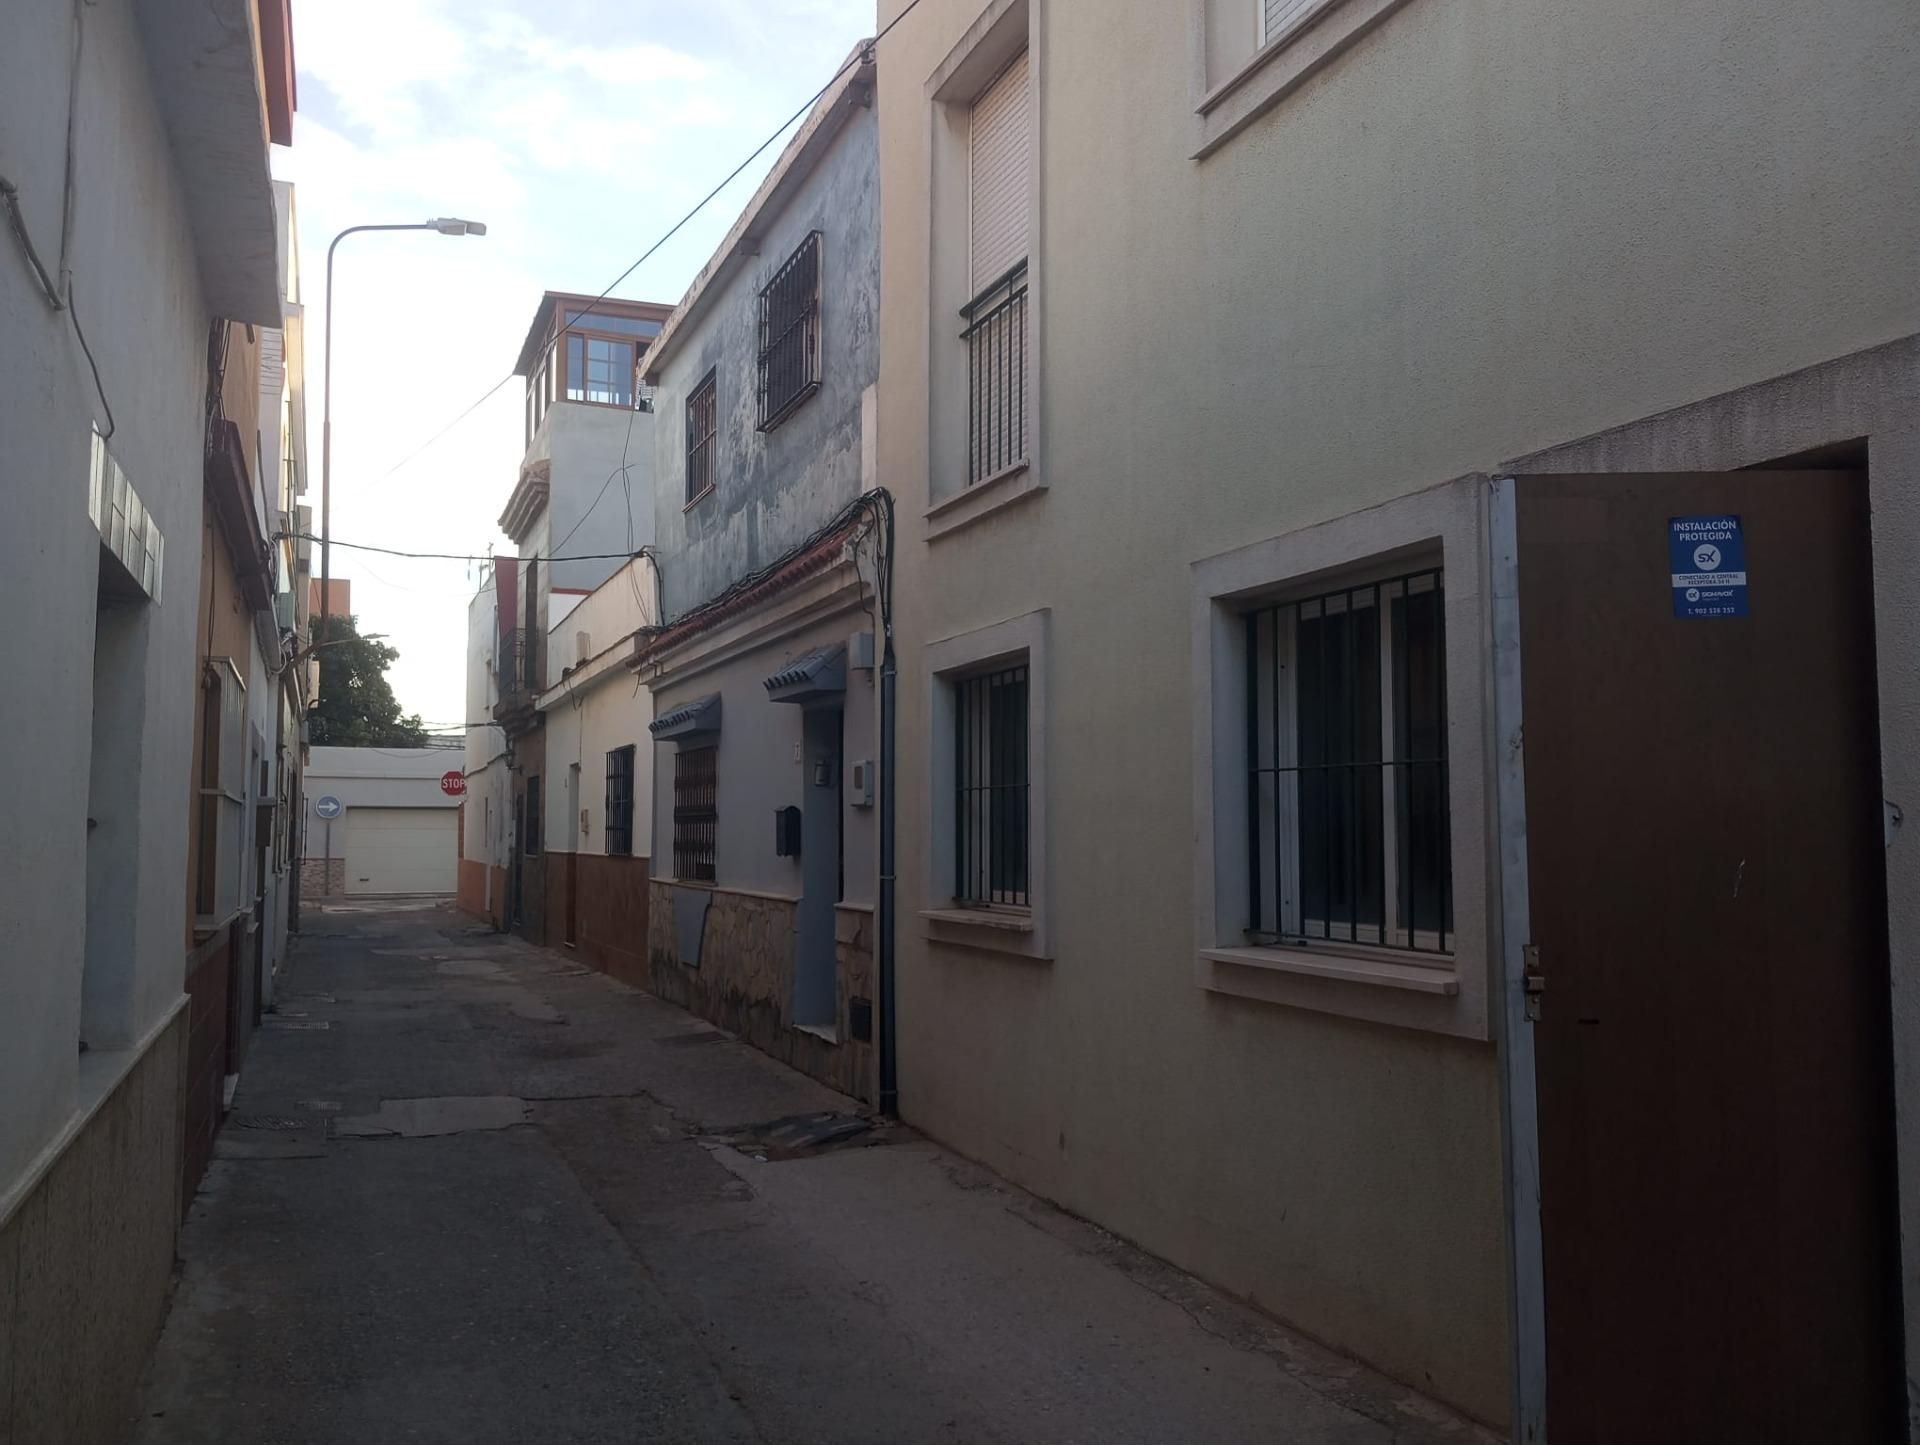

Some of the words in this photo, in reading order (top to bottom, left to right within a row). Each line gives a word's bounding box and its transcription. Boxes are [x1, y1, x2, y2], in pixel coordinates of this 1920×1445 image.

[1673, 520, 1736, 531] INSTALACIÓN
[1679, 532, 1732, 541] PROTEGIDA
[442, 778, 465, 789] STOP
